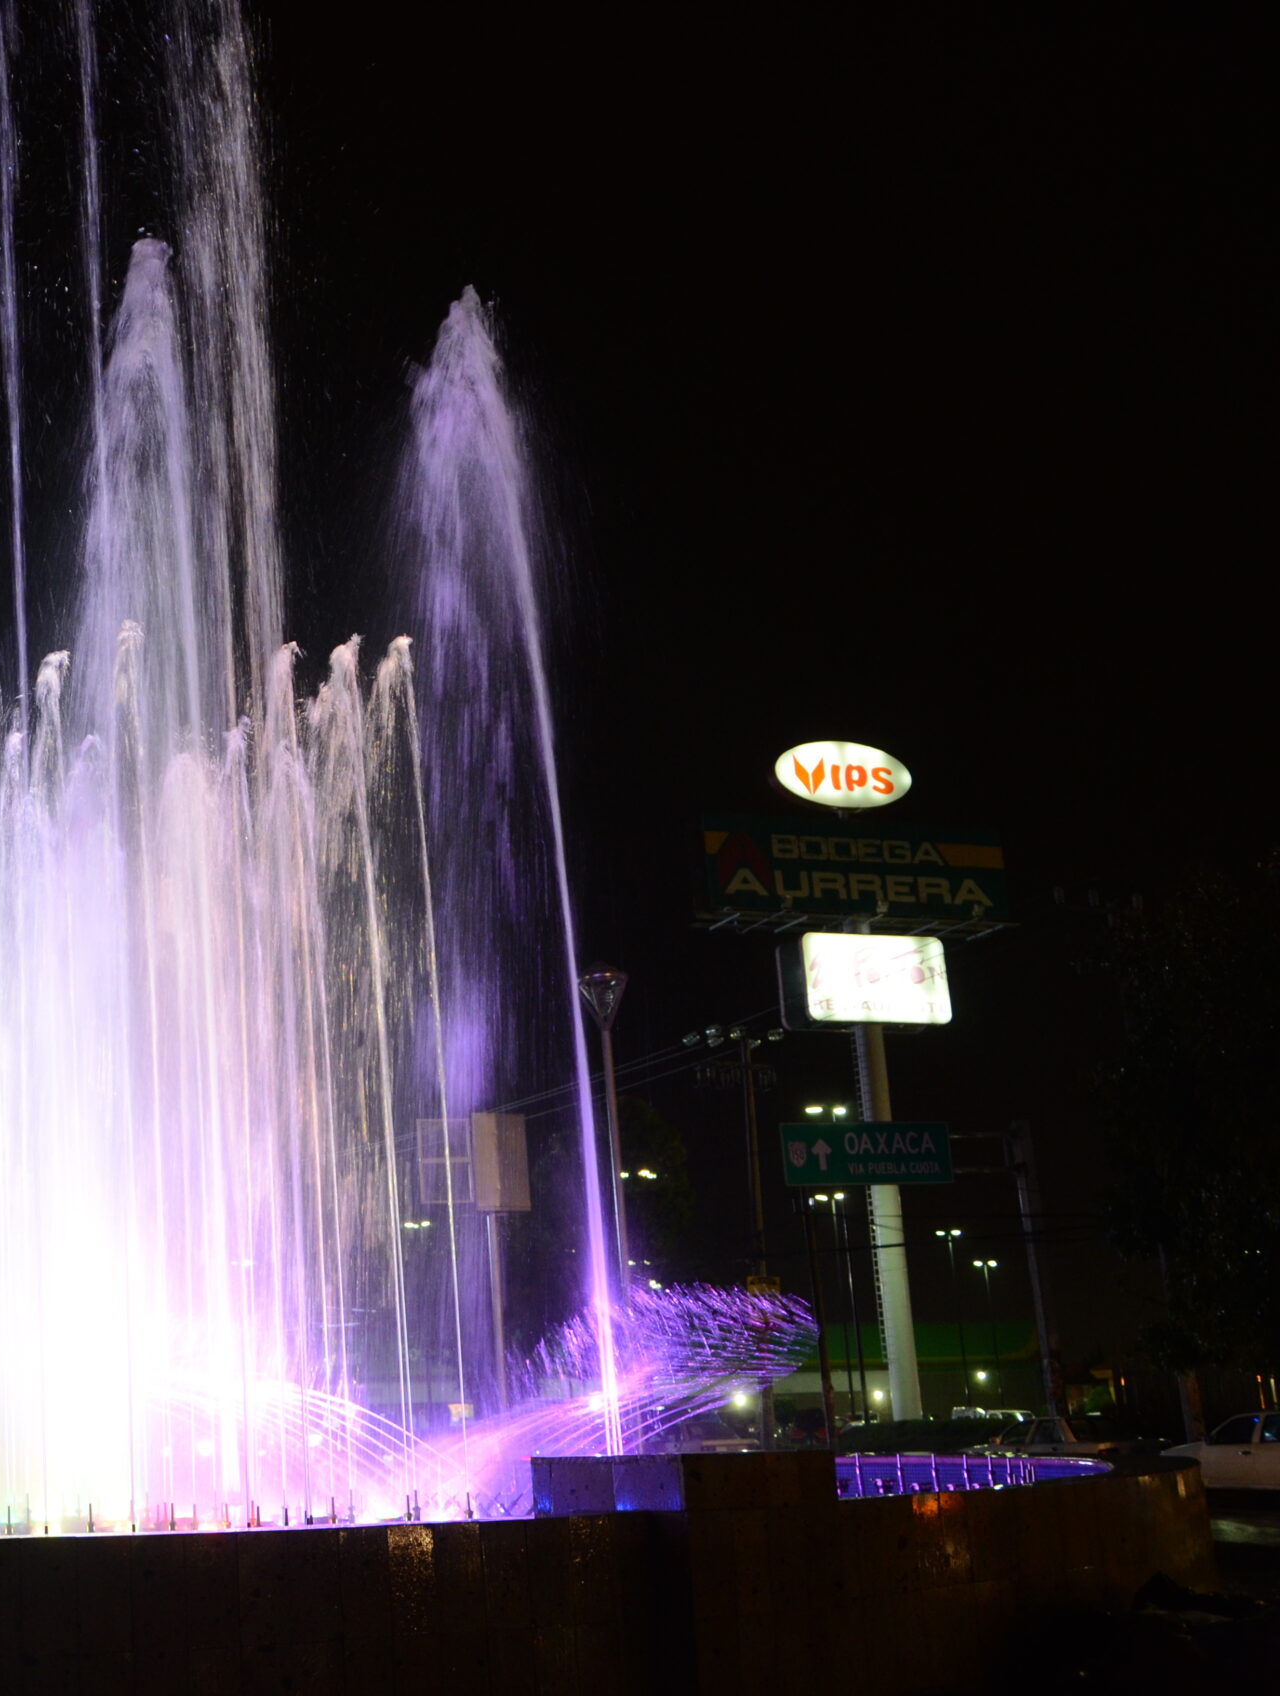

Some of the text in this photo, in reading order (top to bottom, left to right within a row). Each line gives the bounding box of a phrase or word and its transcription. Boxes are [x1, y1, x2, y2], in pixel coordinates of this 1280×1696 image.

[792, 753, 895, 796] VIPS
[770, 833, 946, 867] BODEGA
[724, 867, 993, 907] AURRERA
[843, 1131, 937, 1156] OAXACA
[847, 1162, 865, 1175] VIA
[869, 1162, 907, 1175] PUEBLA
